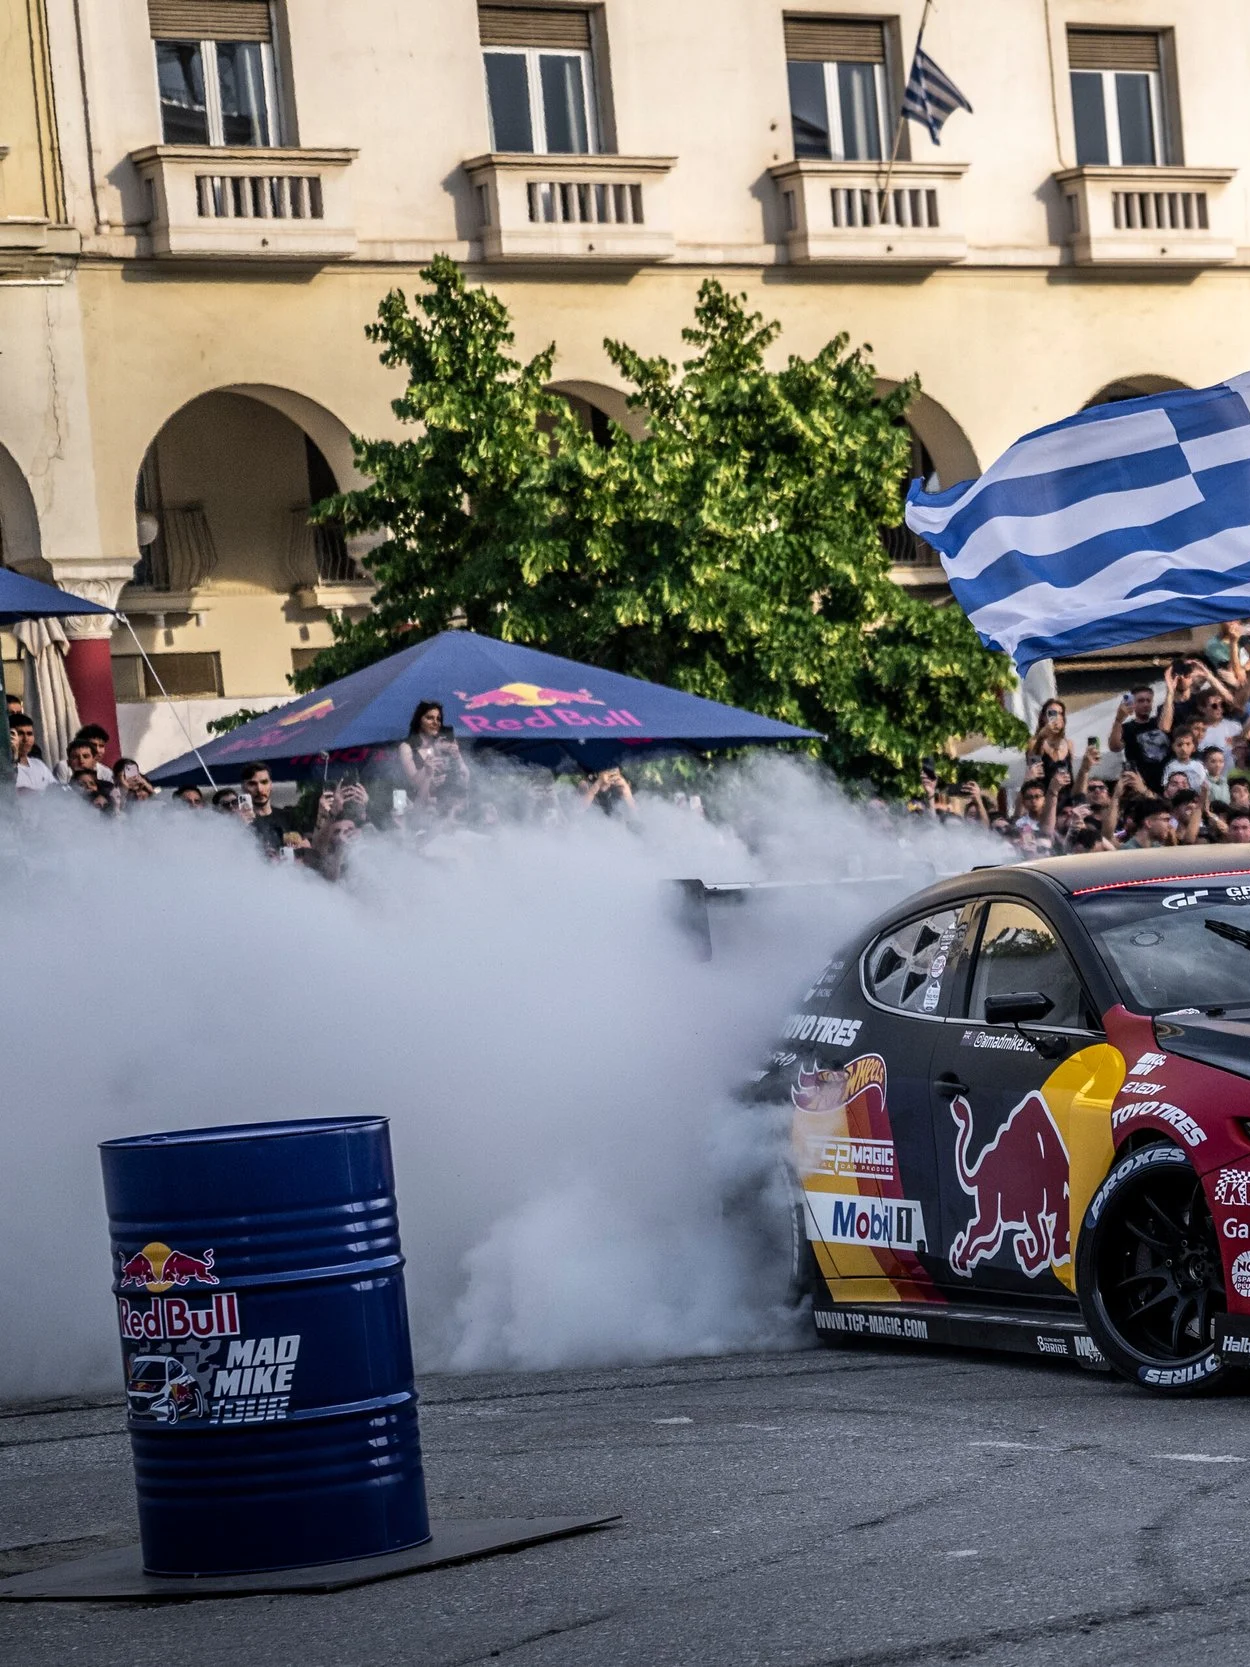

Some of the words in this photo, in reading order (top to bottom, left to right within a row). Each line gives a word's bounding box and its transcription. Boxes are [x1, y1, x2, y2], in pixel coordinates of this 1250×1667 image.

[459, 707, 557, 733] Red
[552, 708, 643, 727] Bull
[810, 1016, 863, 1047] TIRES
[1120, 1082, 1166, 1095] EXEDY
[1112, 1101, 1155, 1129] TOYO
[1152, 1102, 1208, 1147] TIRES
[1091, 1148, 1186, 1220] PROXES
[833, 1201, 892, 1241] Mobil
[119, 1296, 163, 1340] Red
[165, 1292, 240, 1339] Bull
[814, 1310, 928, 1340] WWW.TCP-MAGIC.COM
[226, 1334, 301, 1368] MAD
[1044, 1341, 1069, 1355] BRIDE
[213, 1363, 296, 1398] MIKE
[1145, 1362, 1205, 1385] TIRES
